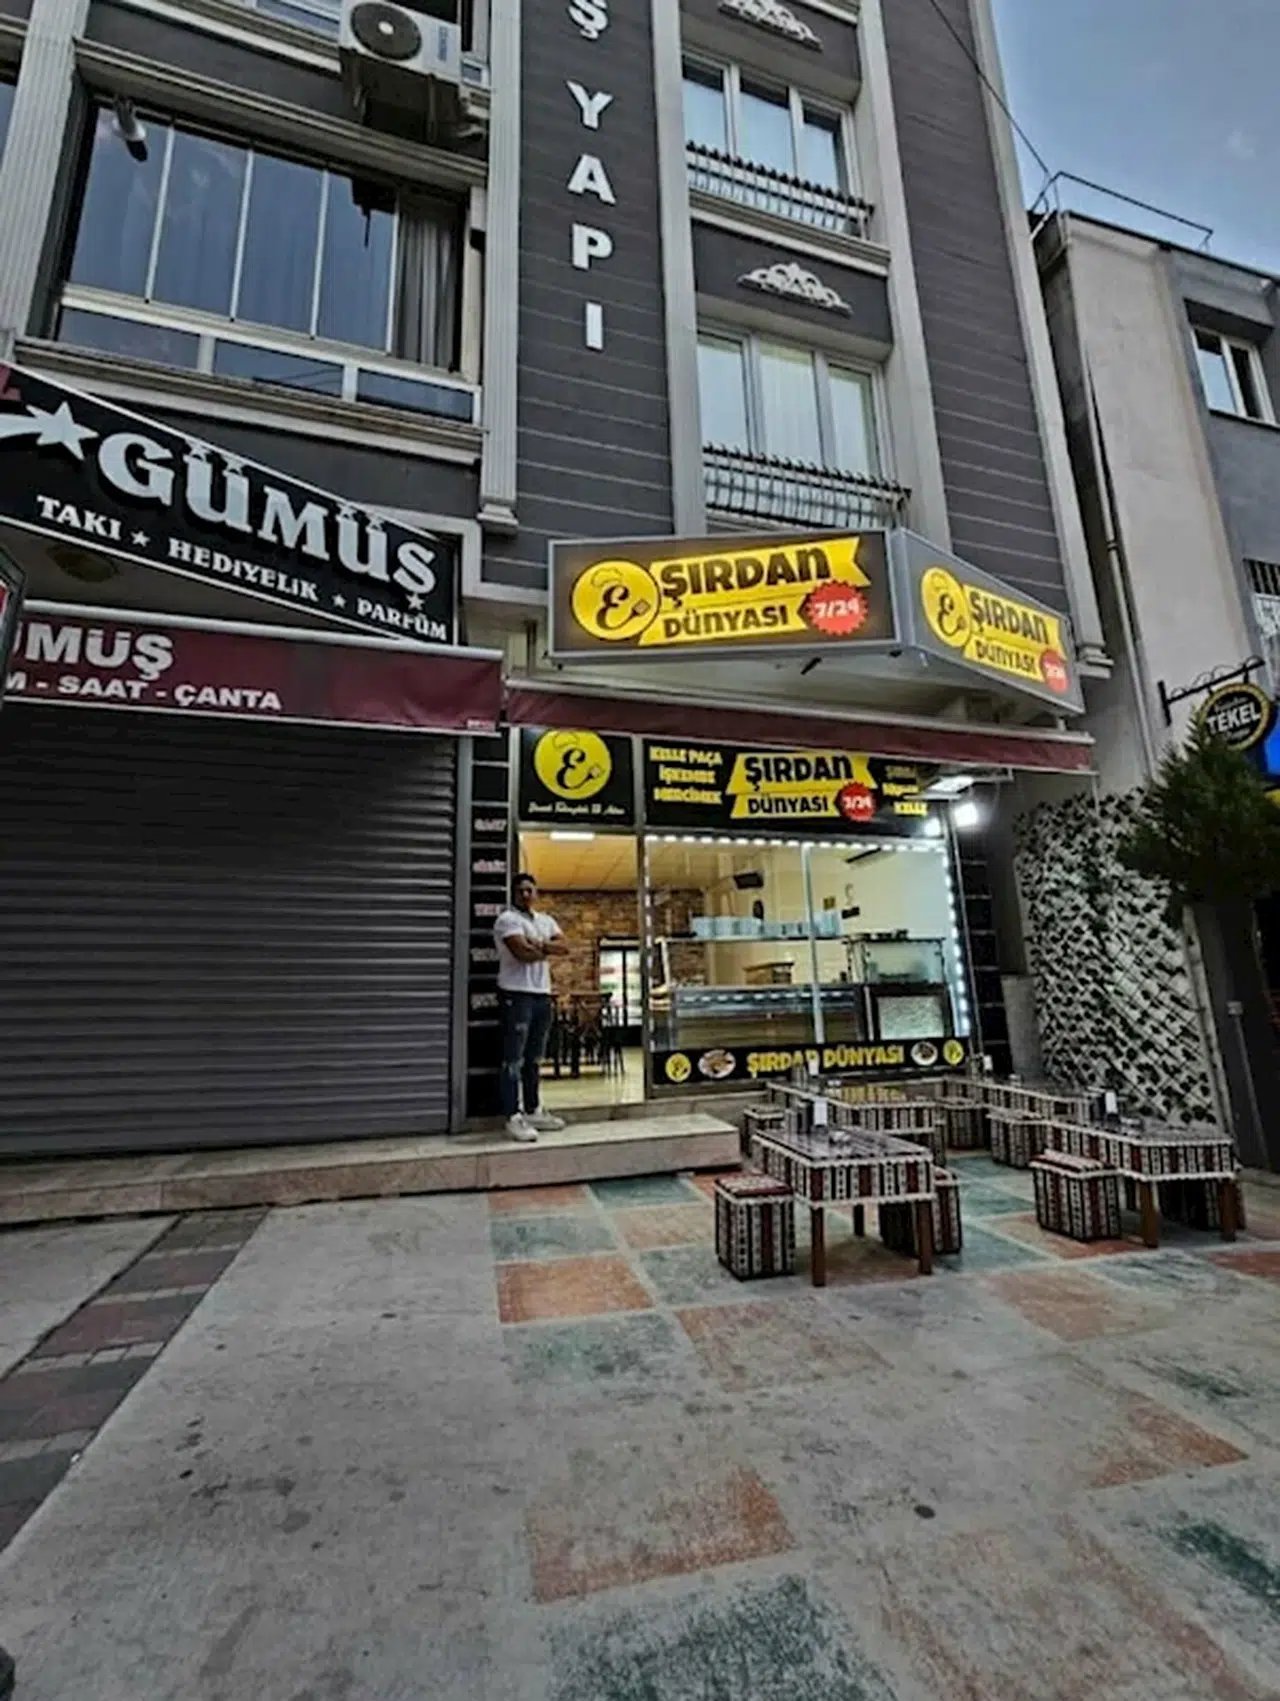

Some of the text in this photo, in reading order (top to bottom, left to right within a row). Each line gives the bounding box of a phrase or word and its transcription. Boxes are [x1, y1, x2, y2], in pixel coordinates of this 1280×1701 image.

[566, 79, 617, 351] YAPI
[36, 495, 123, 541] TAKI
[357, 598, 448, 641] PARFÜM
[98, 431, 437, 611] GÜMÜŞ
[14, 621, 175, 682] MÜŞ
[57, 674, 150, 700] SAAT
[174, 683, 283, 711] ÇANTA
[1206, 701, 1261, 735] TEKEL
